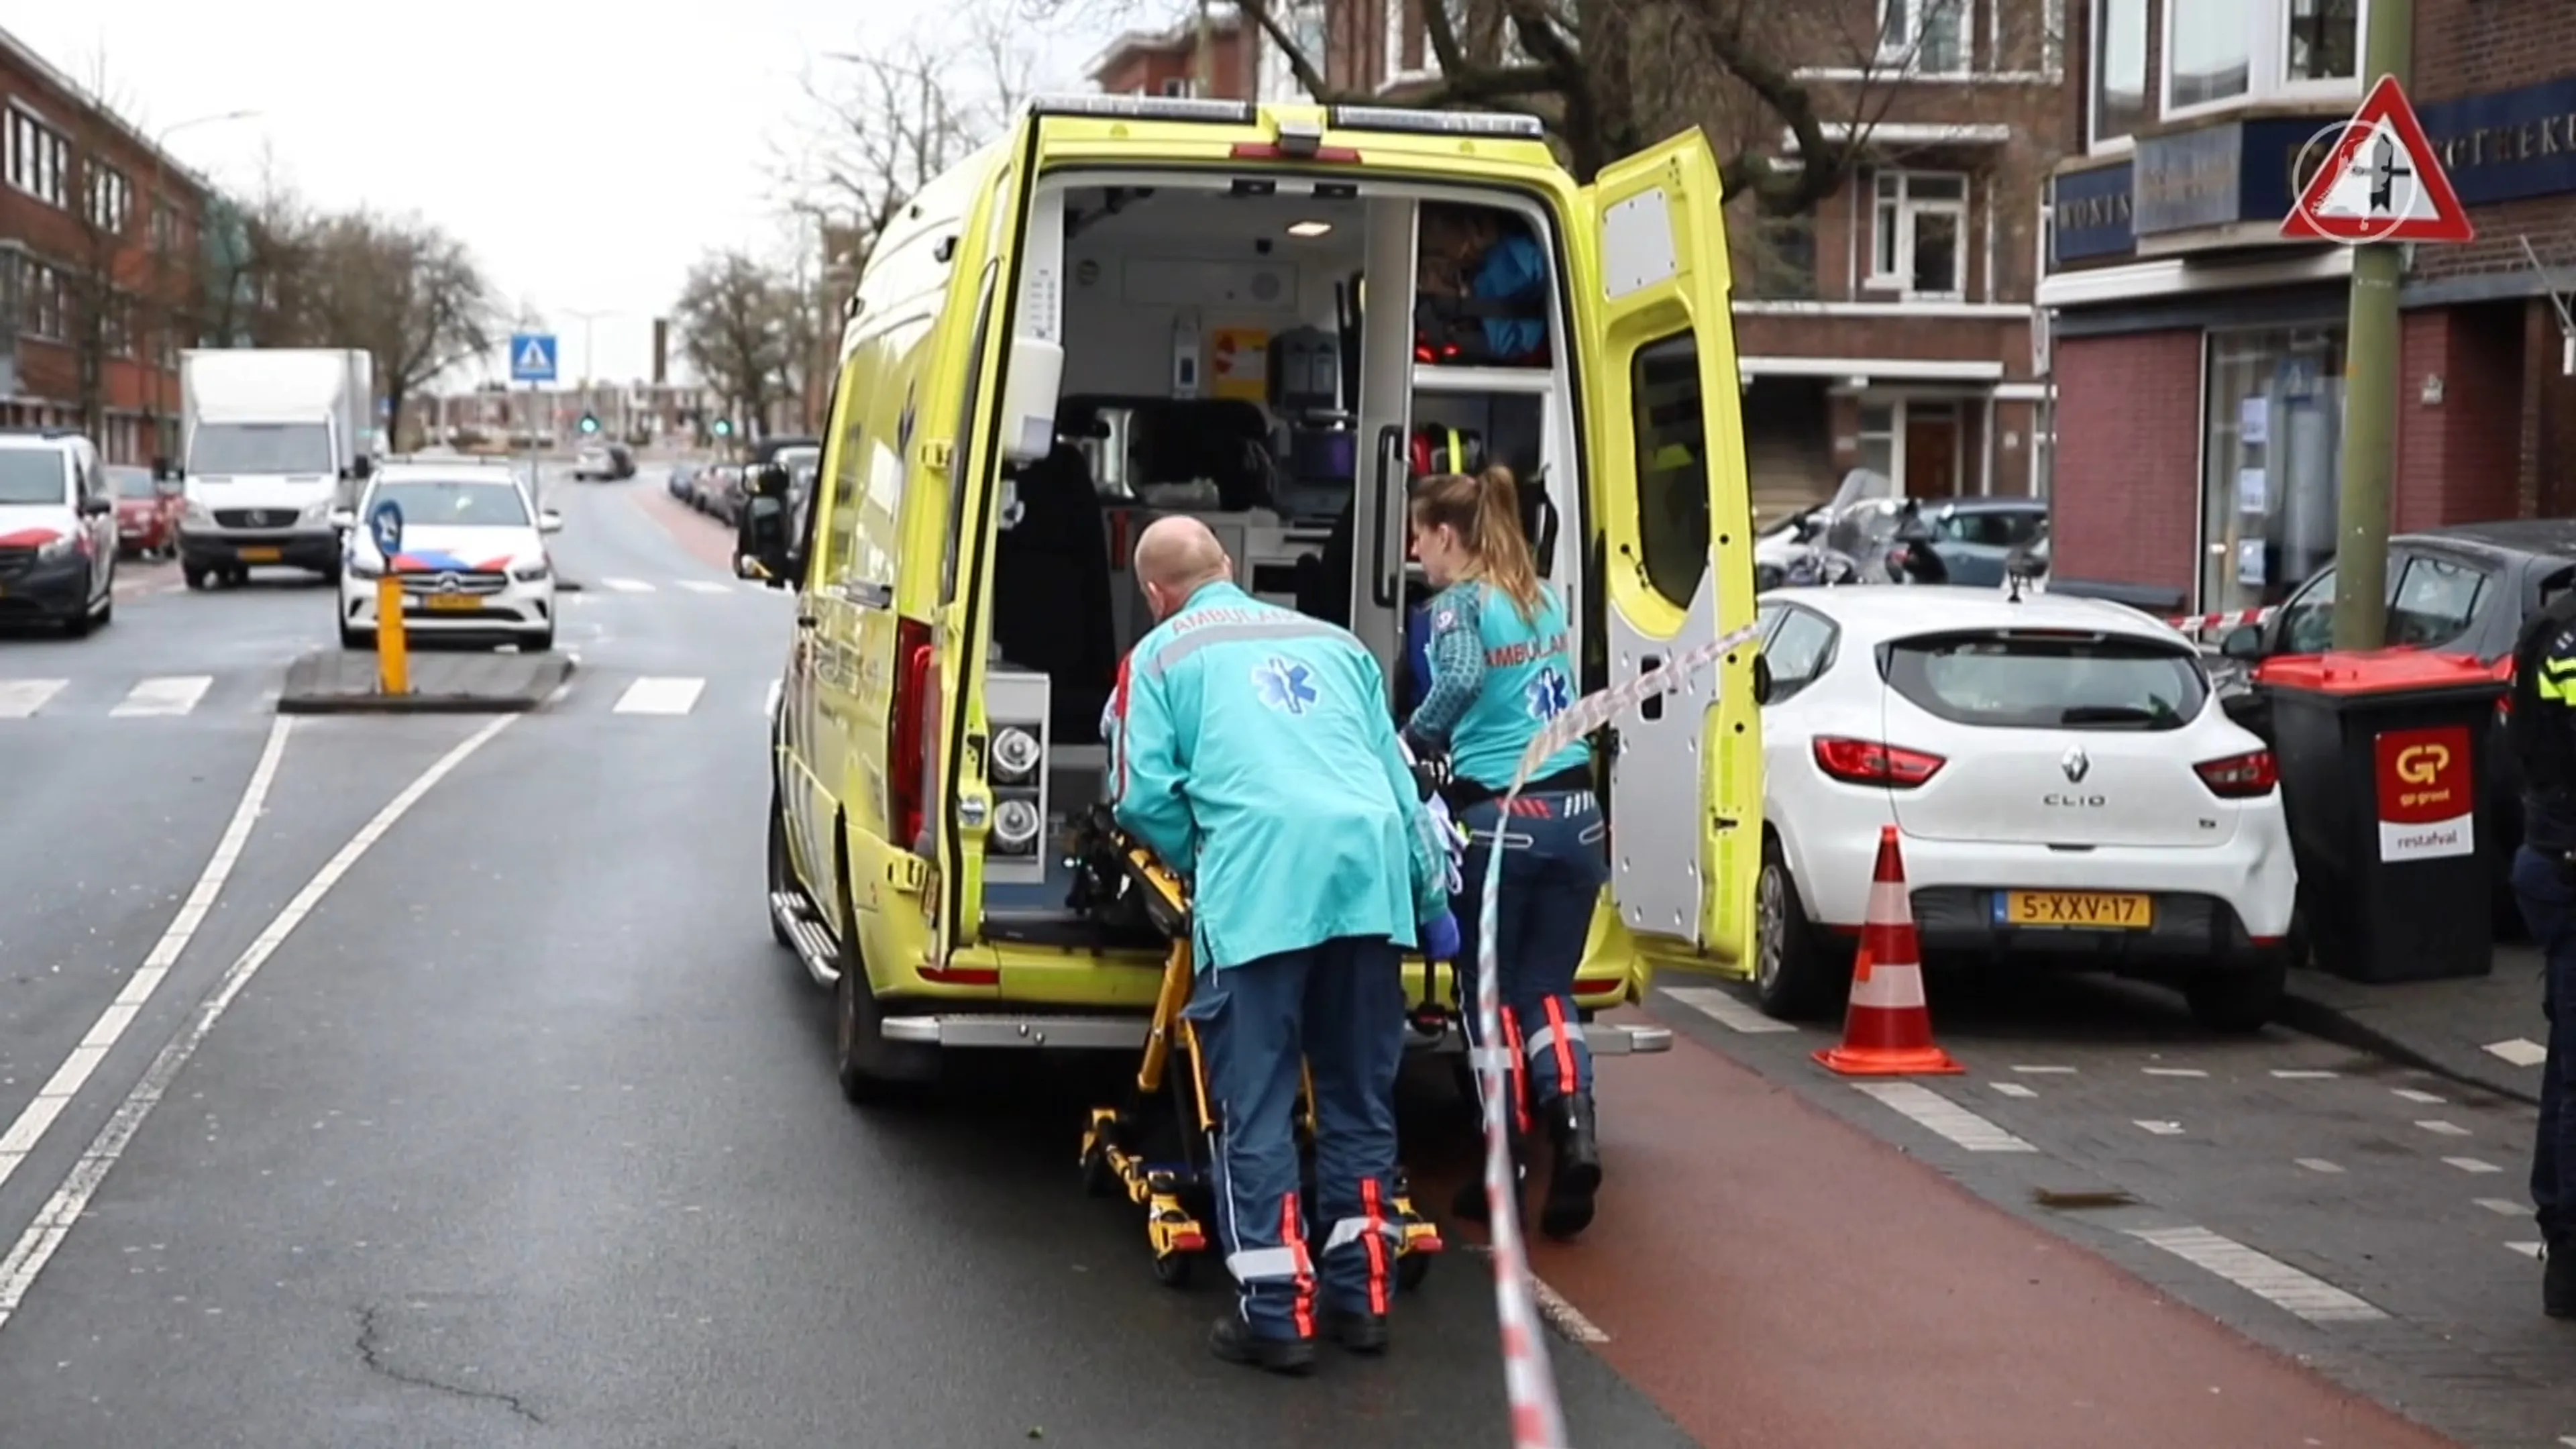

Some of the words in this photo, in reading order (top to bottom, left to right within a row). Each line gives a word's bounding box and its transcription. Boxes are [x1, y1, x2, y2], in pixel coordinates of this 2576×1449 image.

[2396, 742, 2451, 786] GP
[2043, 794, 2106, 806] CLIO
[2400, 794, 2416, 807] gp
[2418, 788, 2451, 806] groot
[2397, 829, 2458, 849] restafval
[2023, 894, 2137, 922] 5-XXV-17
